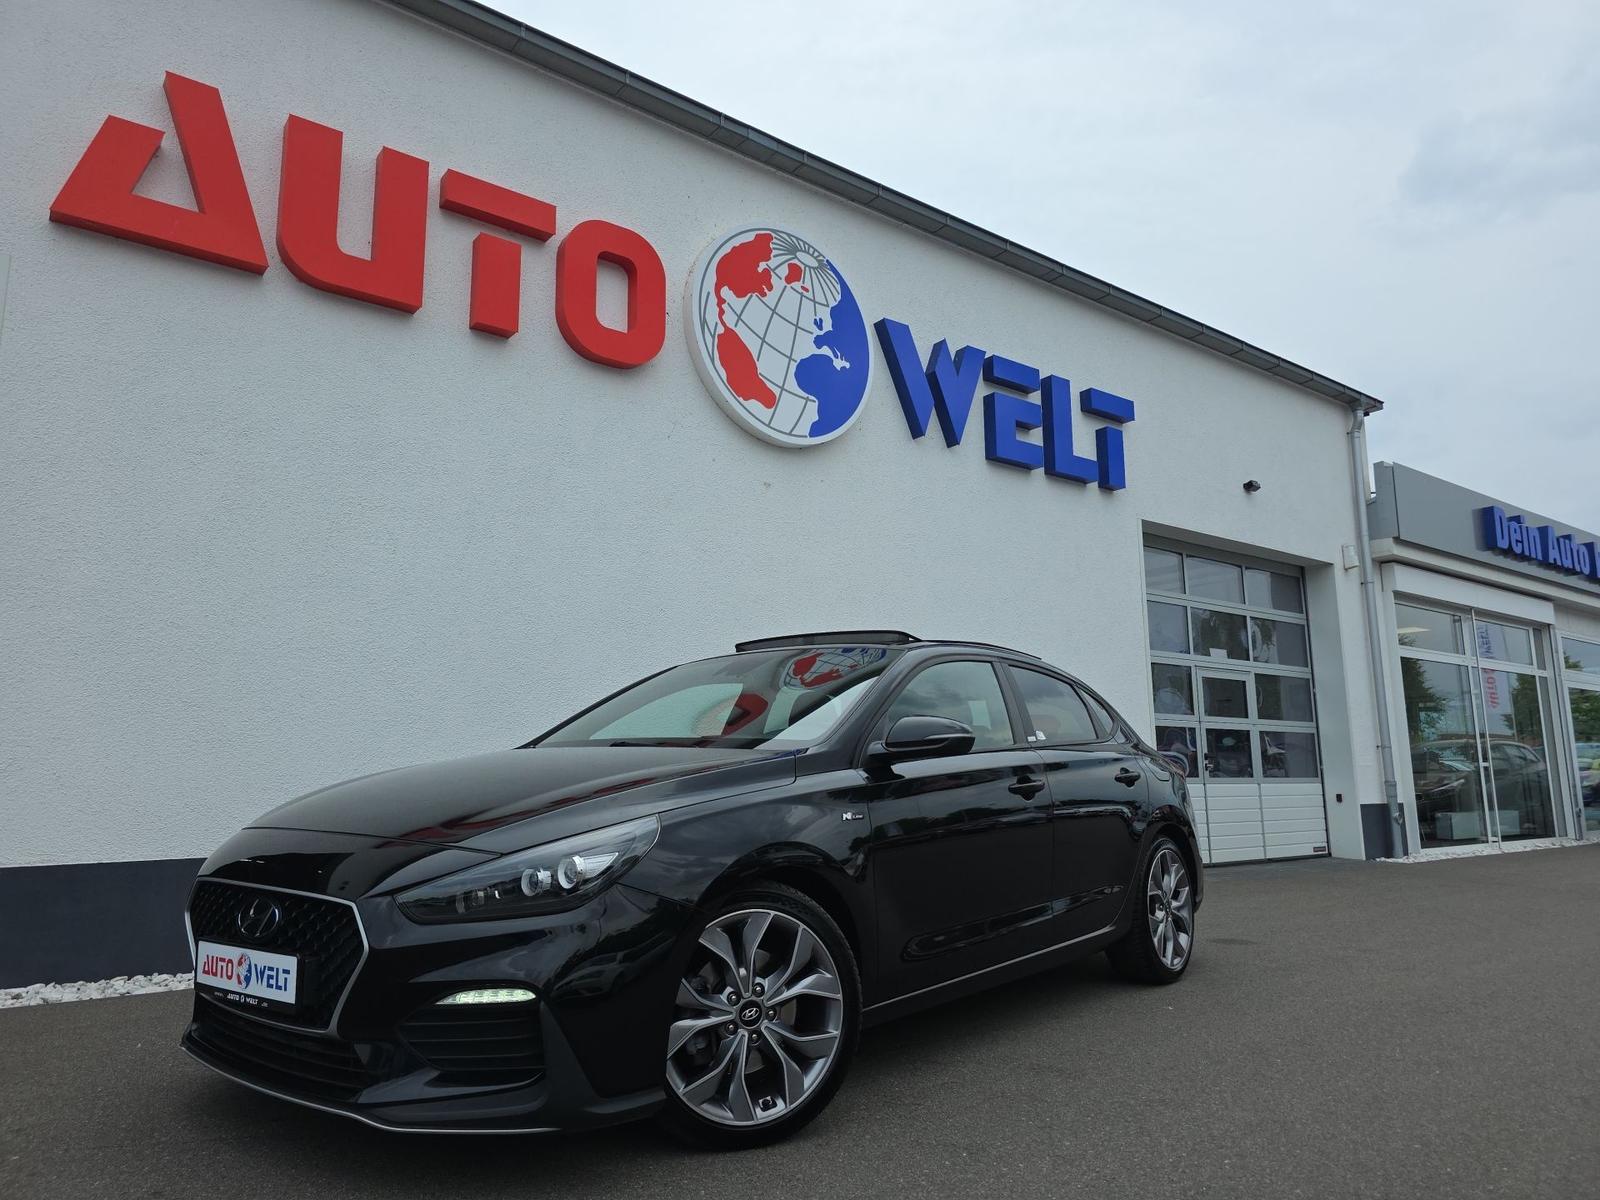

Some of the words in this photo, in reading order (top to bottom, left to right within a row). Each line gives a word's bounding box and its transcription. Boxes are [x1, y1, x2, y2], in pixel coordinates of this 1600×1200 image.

[49, 70, 667, 370] AUTO
[873, 317, 1135, 491] WELT
[1485, 505, 1543, 561] Dein
[1541, 525, 1591, 576] Auto
[202, 954, 234, 981] AUTO
[254, 963, 291, 992] WELT
